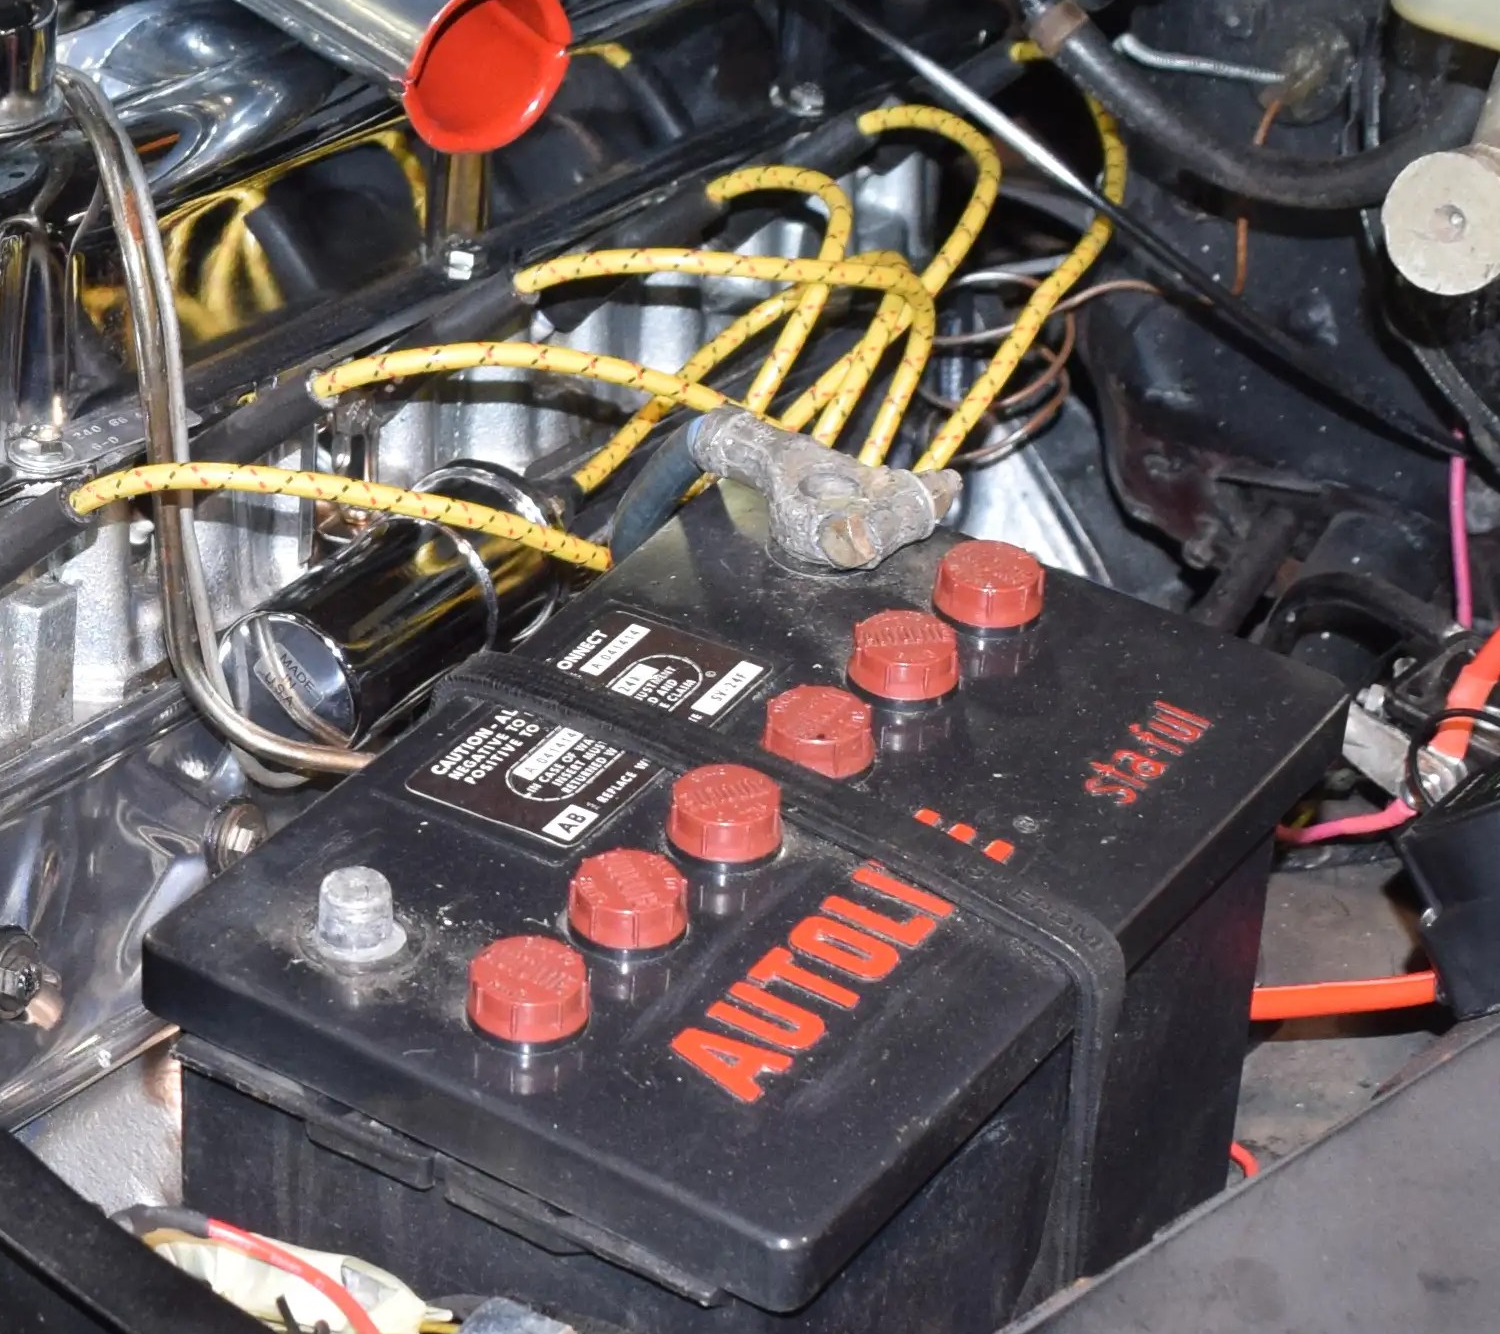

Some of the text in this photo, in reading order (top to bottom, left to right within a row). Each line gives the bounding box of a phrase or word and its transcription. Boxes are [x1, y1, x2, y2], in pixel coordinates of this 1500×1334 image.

[557, 629, 608, 671] ONNECT
[279, 653, 315, 691] MADE
[449, 719, 527, 780] NEGATIVE TO
[552, 755, 585, 788] INSERT
[658, 678, 678, 697] AND
[464, 724, 541, 785] POSITIVE TO
[538, 760, 563, 786] CASE
[561, 756, 607, 794] RETURNED
[597, 771, 638, 804] REPLACE
[557, 812, 588, 835] AB
[670, 807, 1014, 1103] AUTOLI
